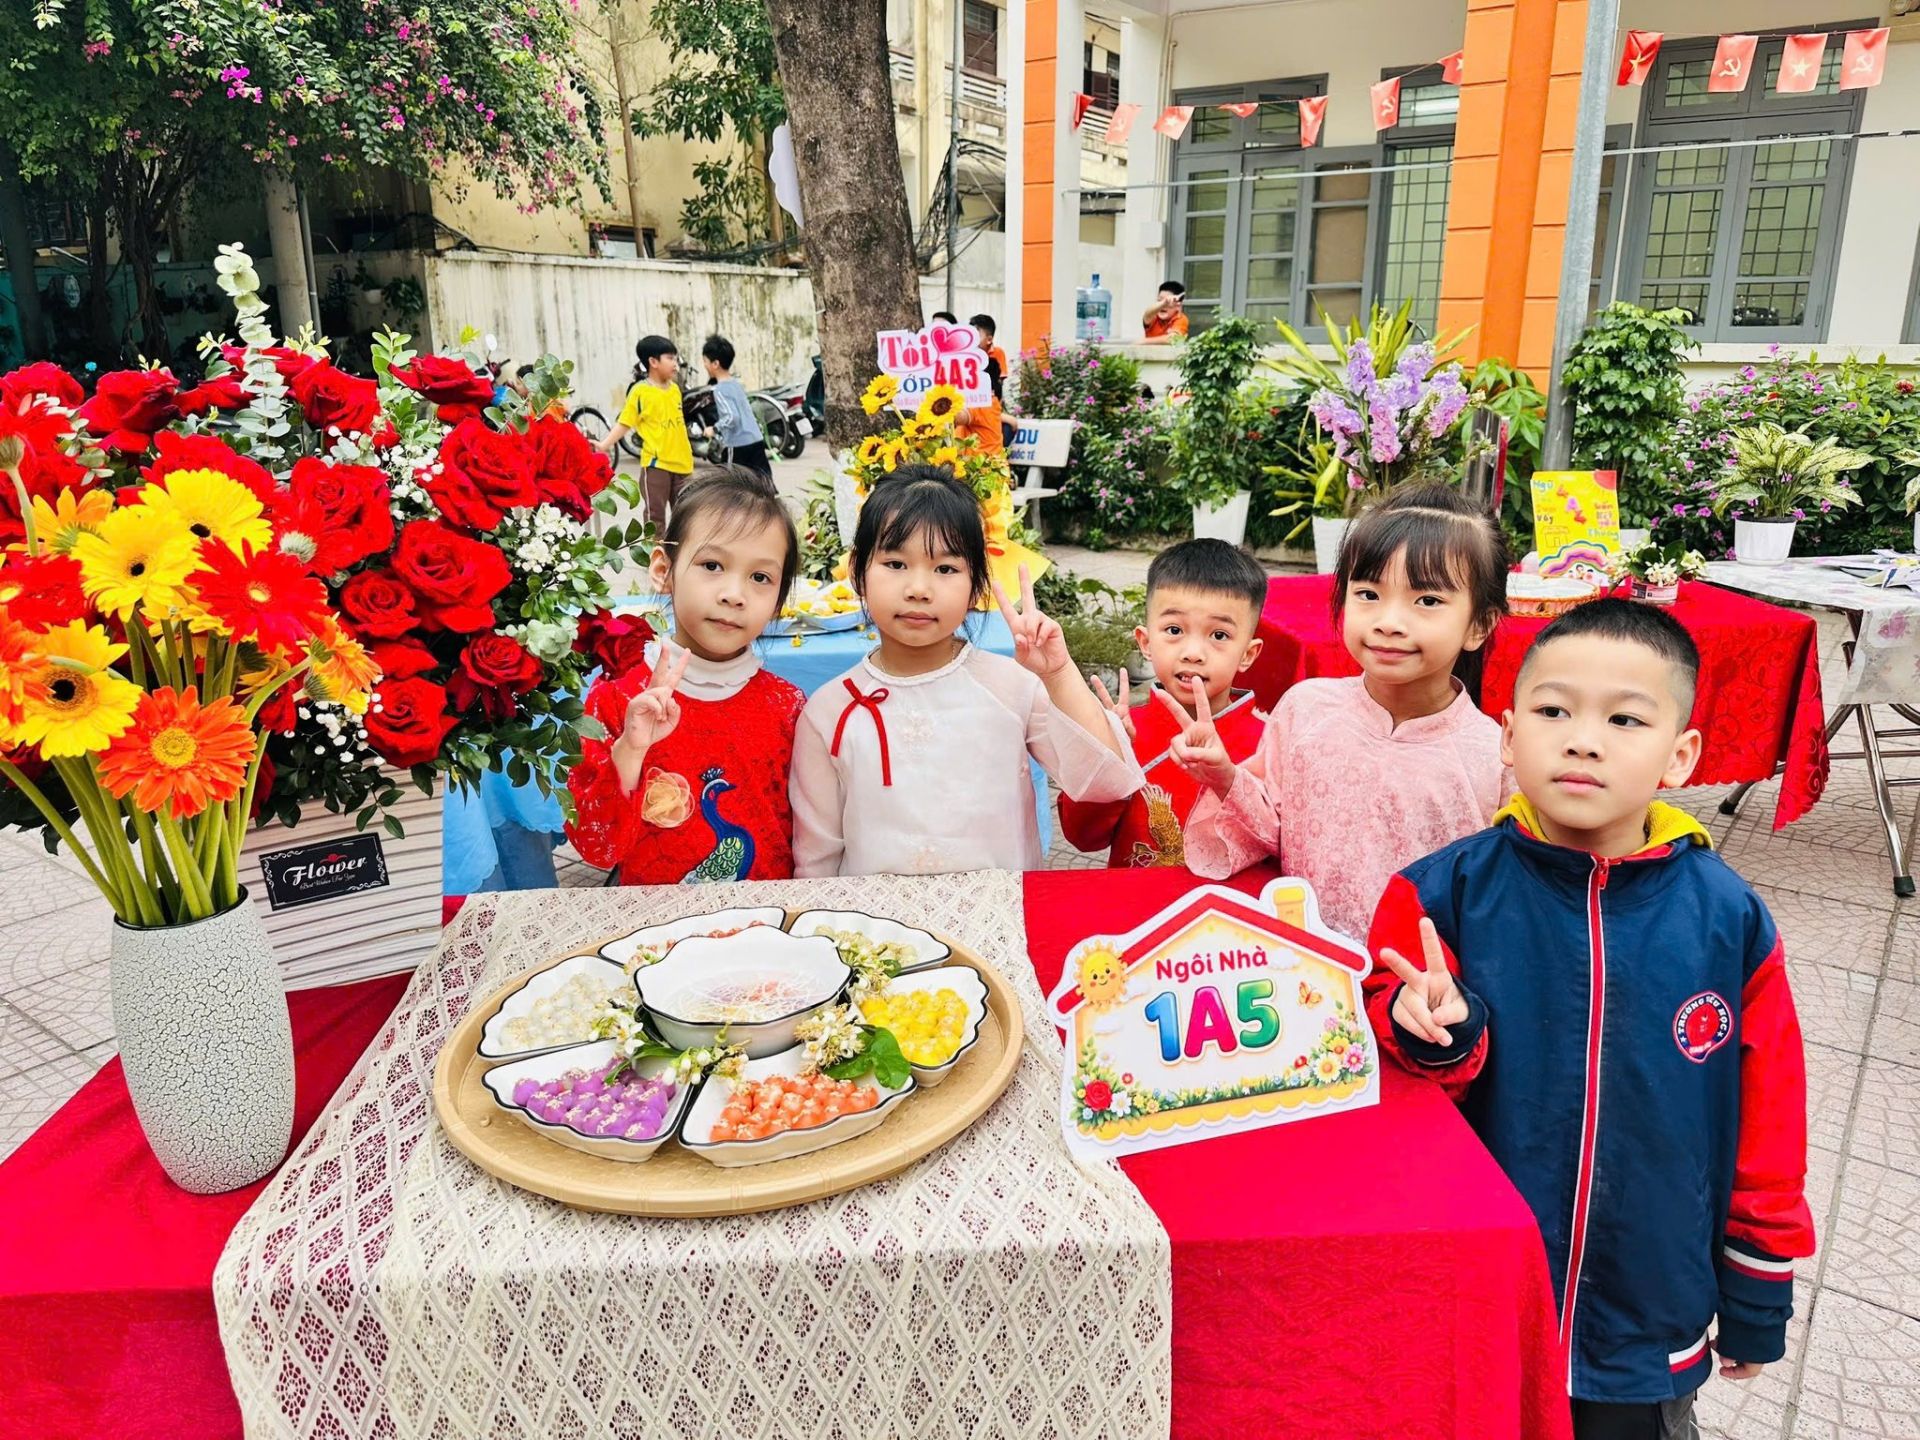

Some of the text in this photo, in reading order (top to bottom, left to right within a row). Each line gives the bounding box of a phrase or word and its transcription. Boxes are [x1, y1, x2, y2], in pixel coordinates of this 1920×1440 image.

[881, 334, 931, 368] Tôi
[898, 358, 978, 393] ỚP 4A3
[1012, 428, 1039, 445] DU
[282, 856, 367, 886] Flower
[1156, 945, 1268, 983] Ngôi Nhà
[1144, 978, 1280, 1062] 1A5
